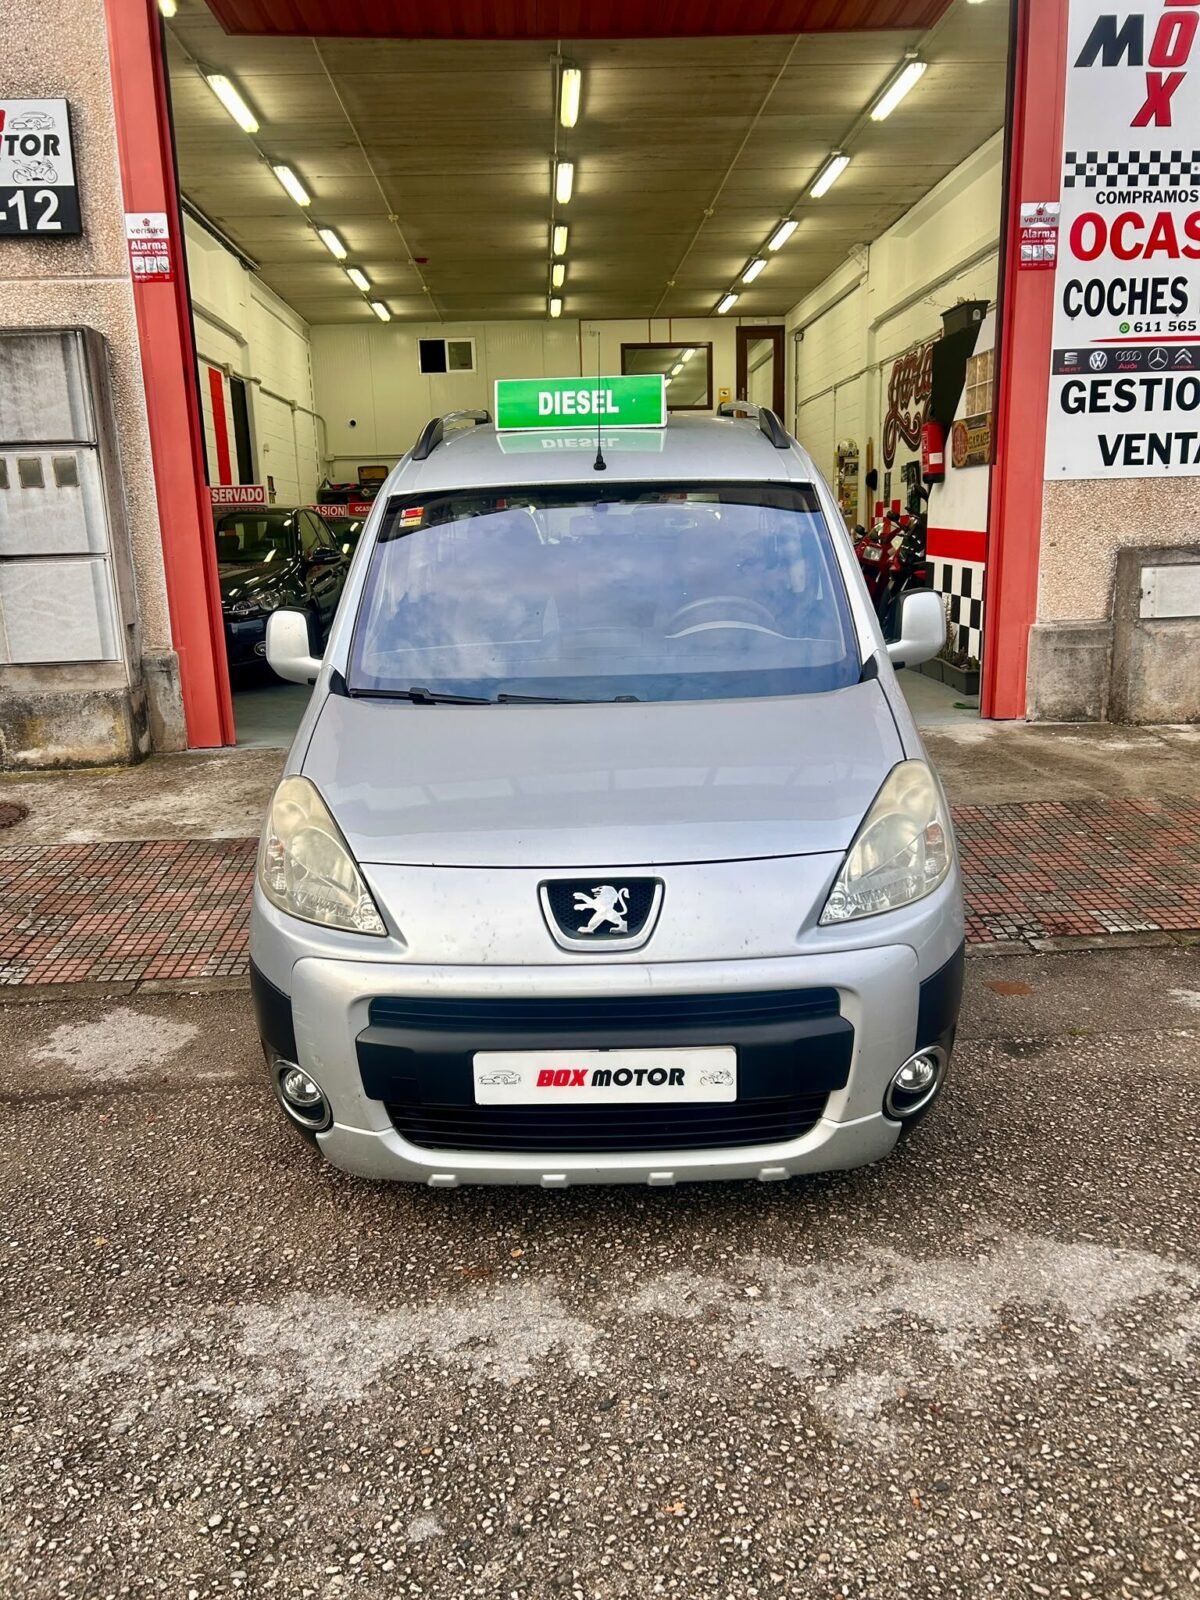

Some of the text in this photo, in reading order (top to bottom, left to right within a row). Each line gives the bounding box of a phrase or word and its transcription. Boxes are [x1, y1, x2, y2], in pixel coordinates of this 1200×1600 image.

[0, 134, 60, 156] TOR
[1096, 190, 1199, 205] COMPRAMOS
[1024, 215, 1056, 223] verisure
[1022, 228, 1056, 239] Alarma
[131, 239, 167, 250] Alarma
[1063, 276, 1189, 318] COCHES
[1134, 320, 1197, 333] 611 565
[1118, 362, 1138, 370] Audi
[538, 389, 620, 416] DIESEL
[1060, 376, 1200, 415] GESTIO
[211, 487, 263, 503] SERVADO
[536, 1067, 686, 1088] BOX MOTOR
